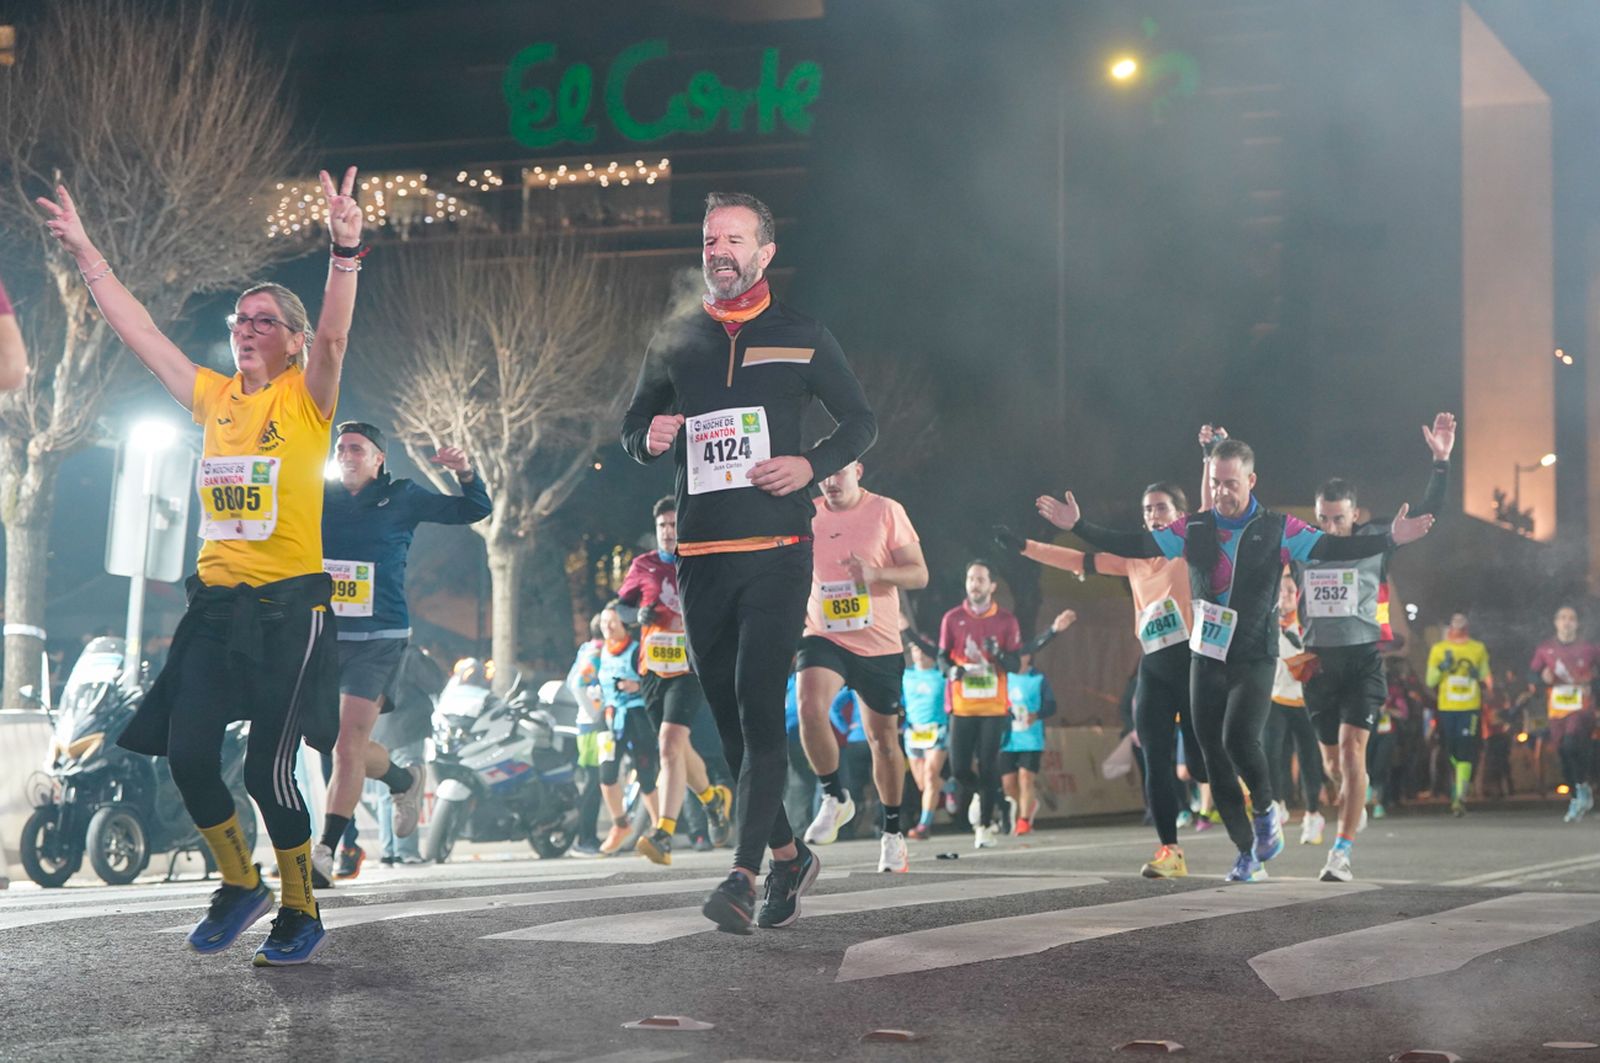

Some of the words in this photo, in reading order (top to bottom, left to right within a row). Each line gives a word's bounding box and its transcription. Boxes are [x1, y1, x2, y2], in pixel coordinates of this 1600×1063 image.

[503, 42, 597, 147] El
[605, 39, 823, 141] Corte
[703, 420, 723, 431] NOCHE
[724, 418, 734, 426] DE
[695, 432, 709, 443] SAN
[703, 436, 752, 464] 4124
[204, 476, 219, 487] SAN
[212, 486, 261, 512] 8805
[1313, 586, 1348, 600] 2532
[832, 597, 860, 615] 836
[1145, 613, 1178, 637] 12847
[653, 646, 681, 659] 6898
